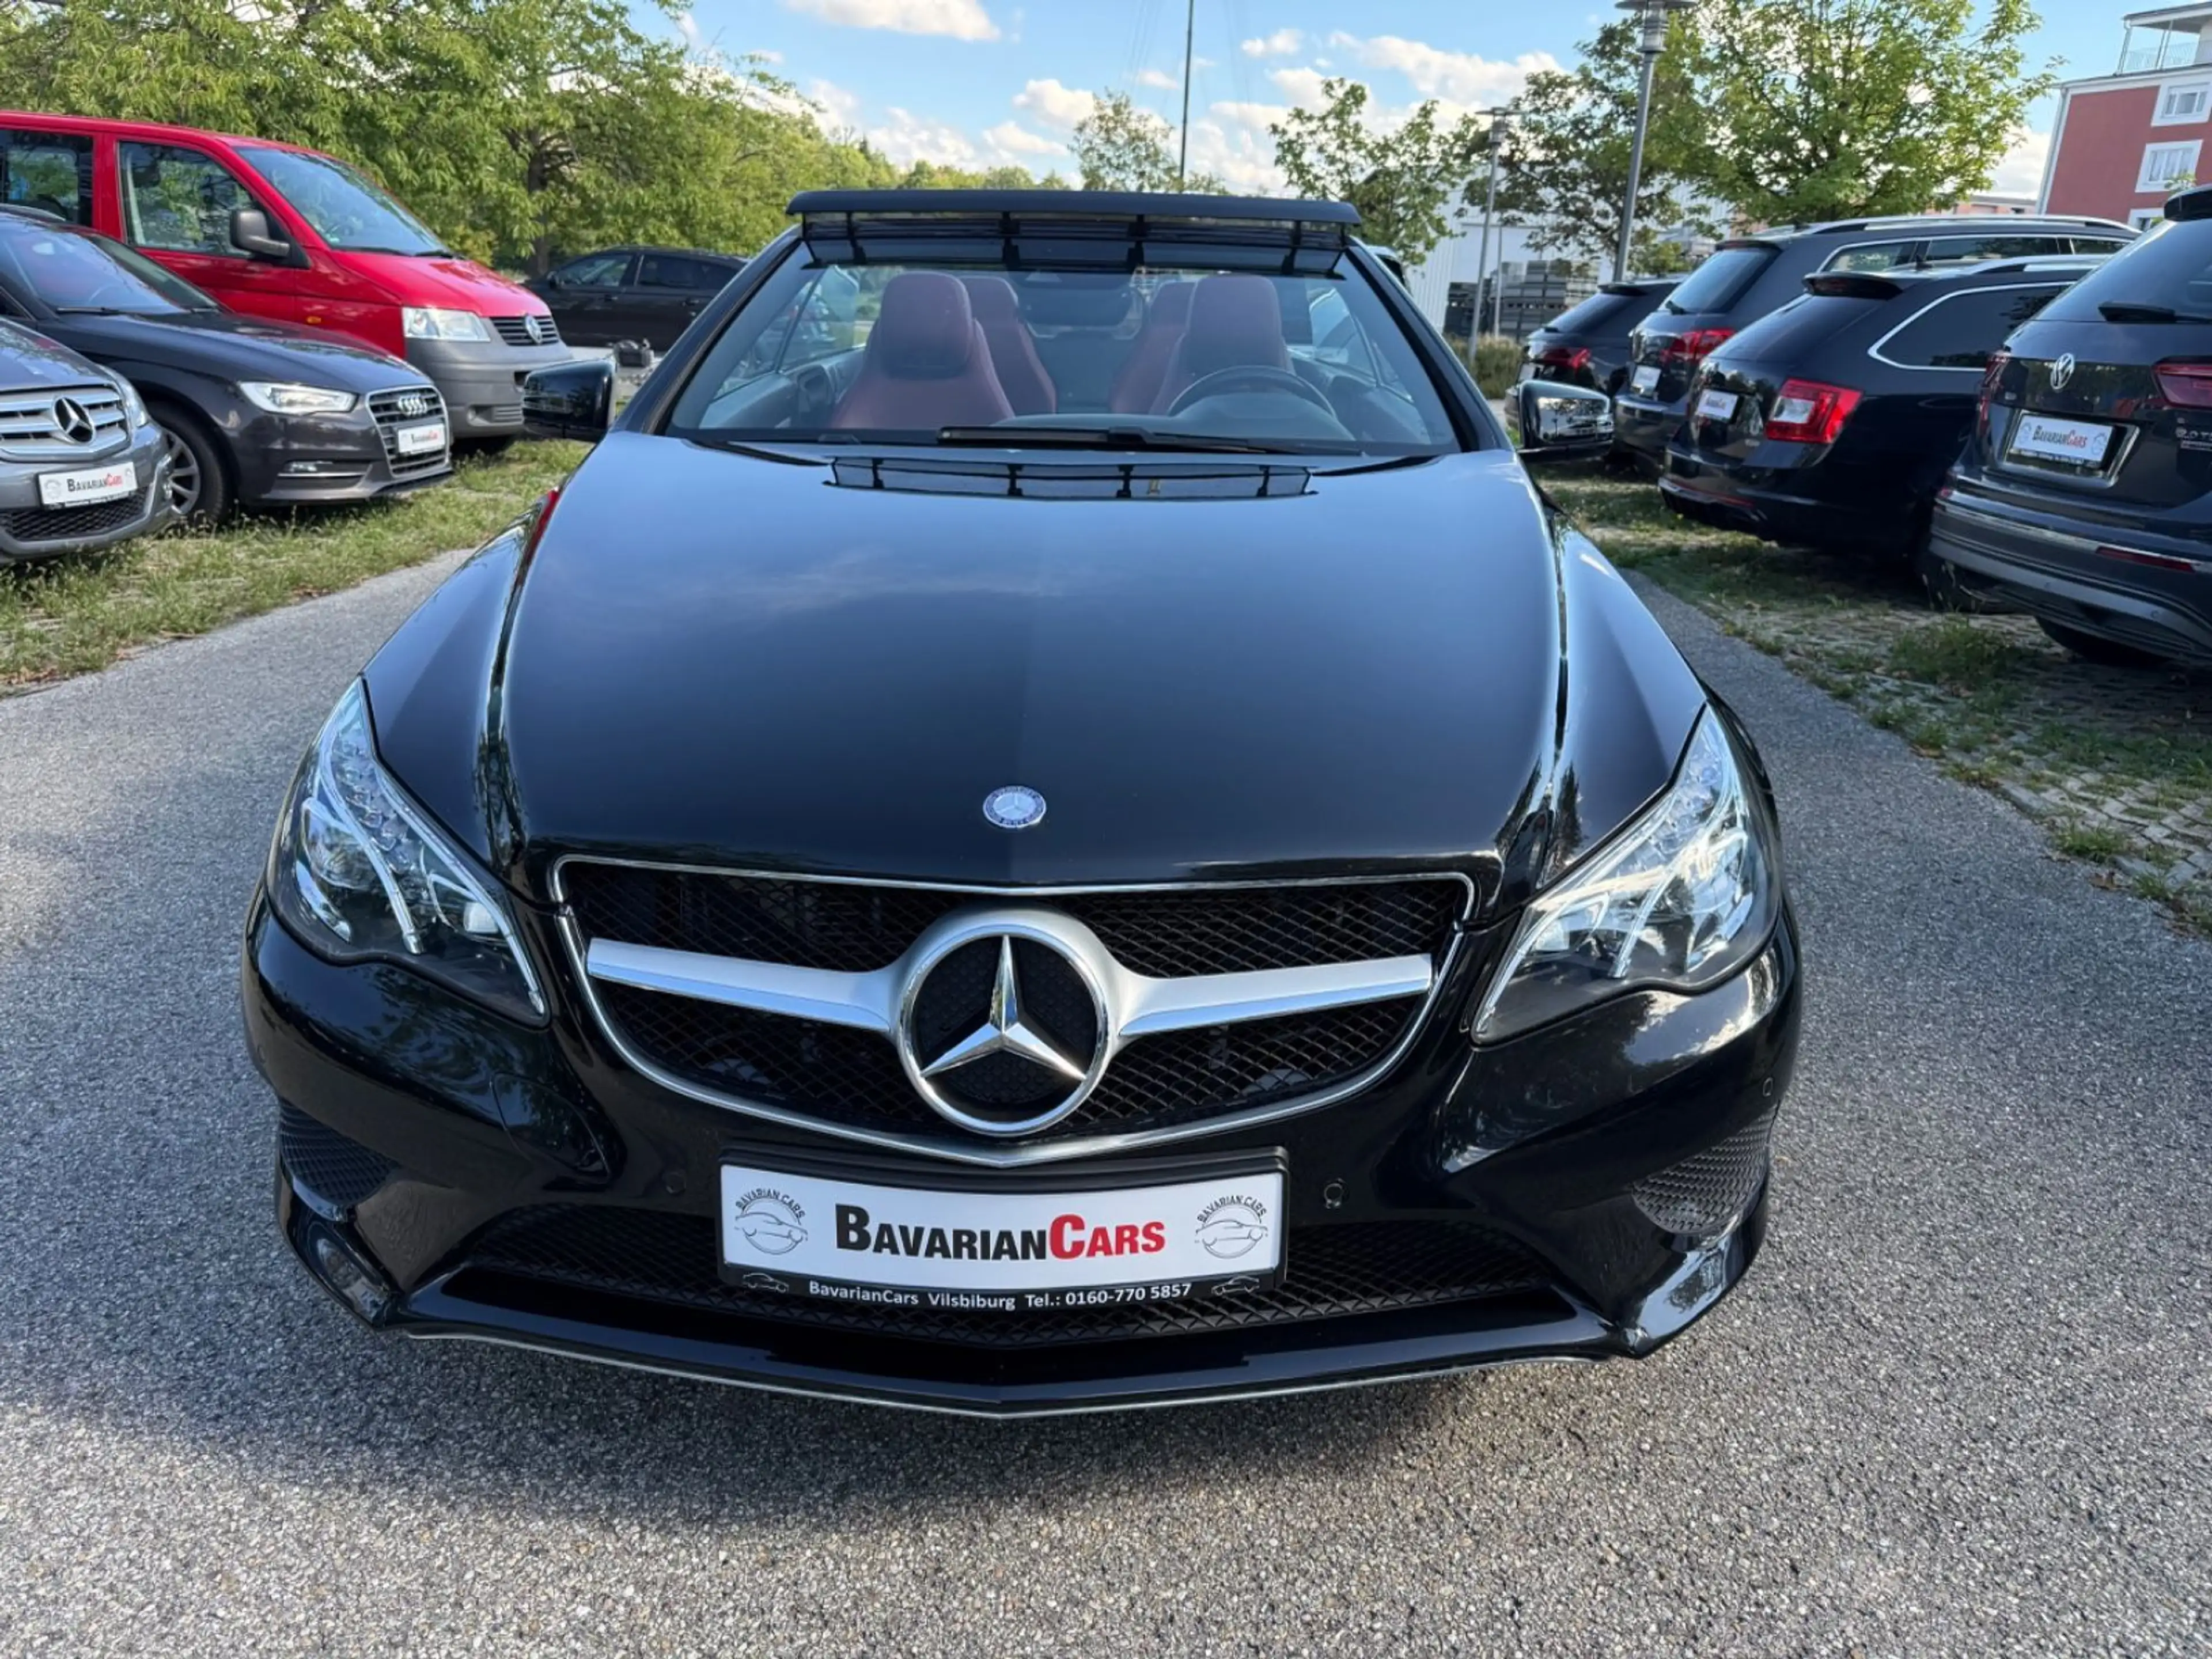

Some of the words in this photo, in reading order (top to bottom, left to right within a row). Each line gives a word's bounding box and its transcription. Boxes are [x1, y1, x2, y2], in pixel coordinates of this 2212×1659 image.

[736, 1188, 780, 1213] BAVARIAN
[781, 1194, 805, 1219] CARS
[1197, 1195, 1243, 1223] BAVARIAN
[1244, 1196, 1267, 1218] CARS
[809, 1280, 919, 1305] BavarianCars
[927, 1293, 1016, 1311] Vilsbiburg
[1025, 1294, 1060, 1307] Tel.:
[1065, 1287, 1146, 1305] 0160-770
[1150, 1283, 1191, 1299] 5857
